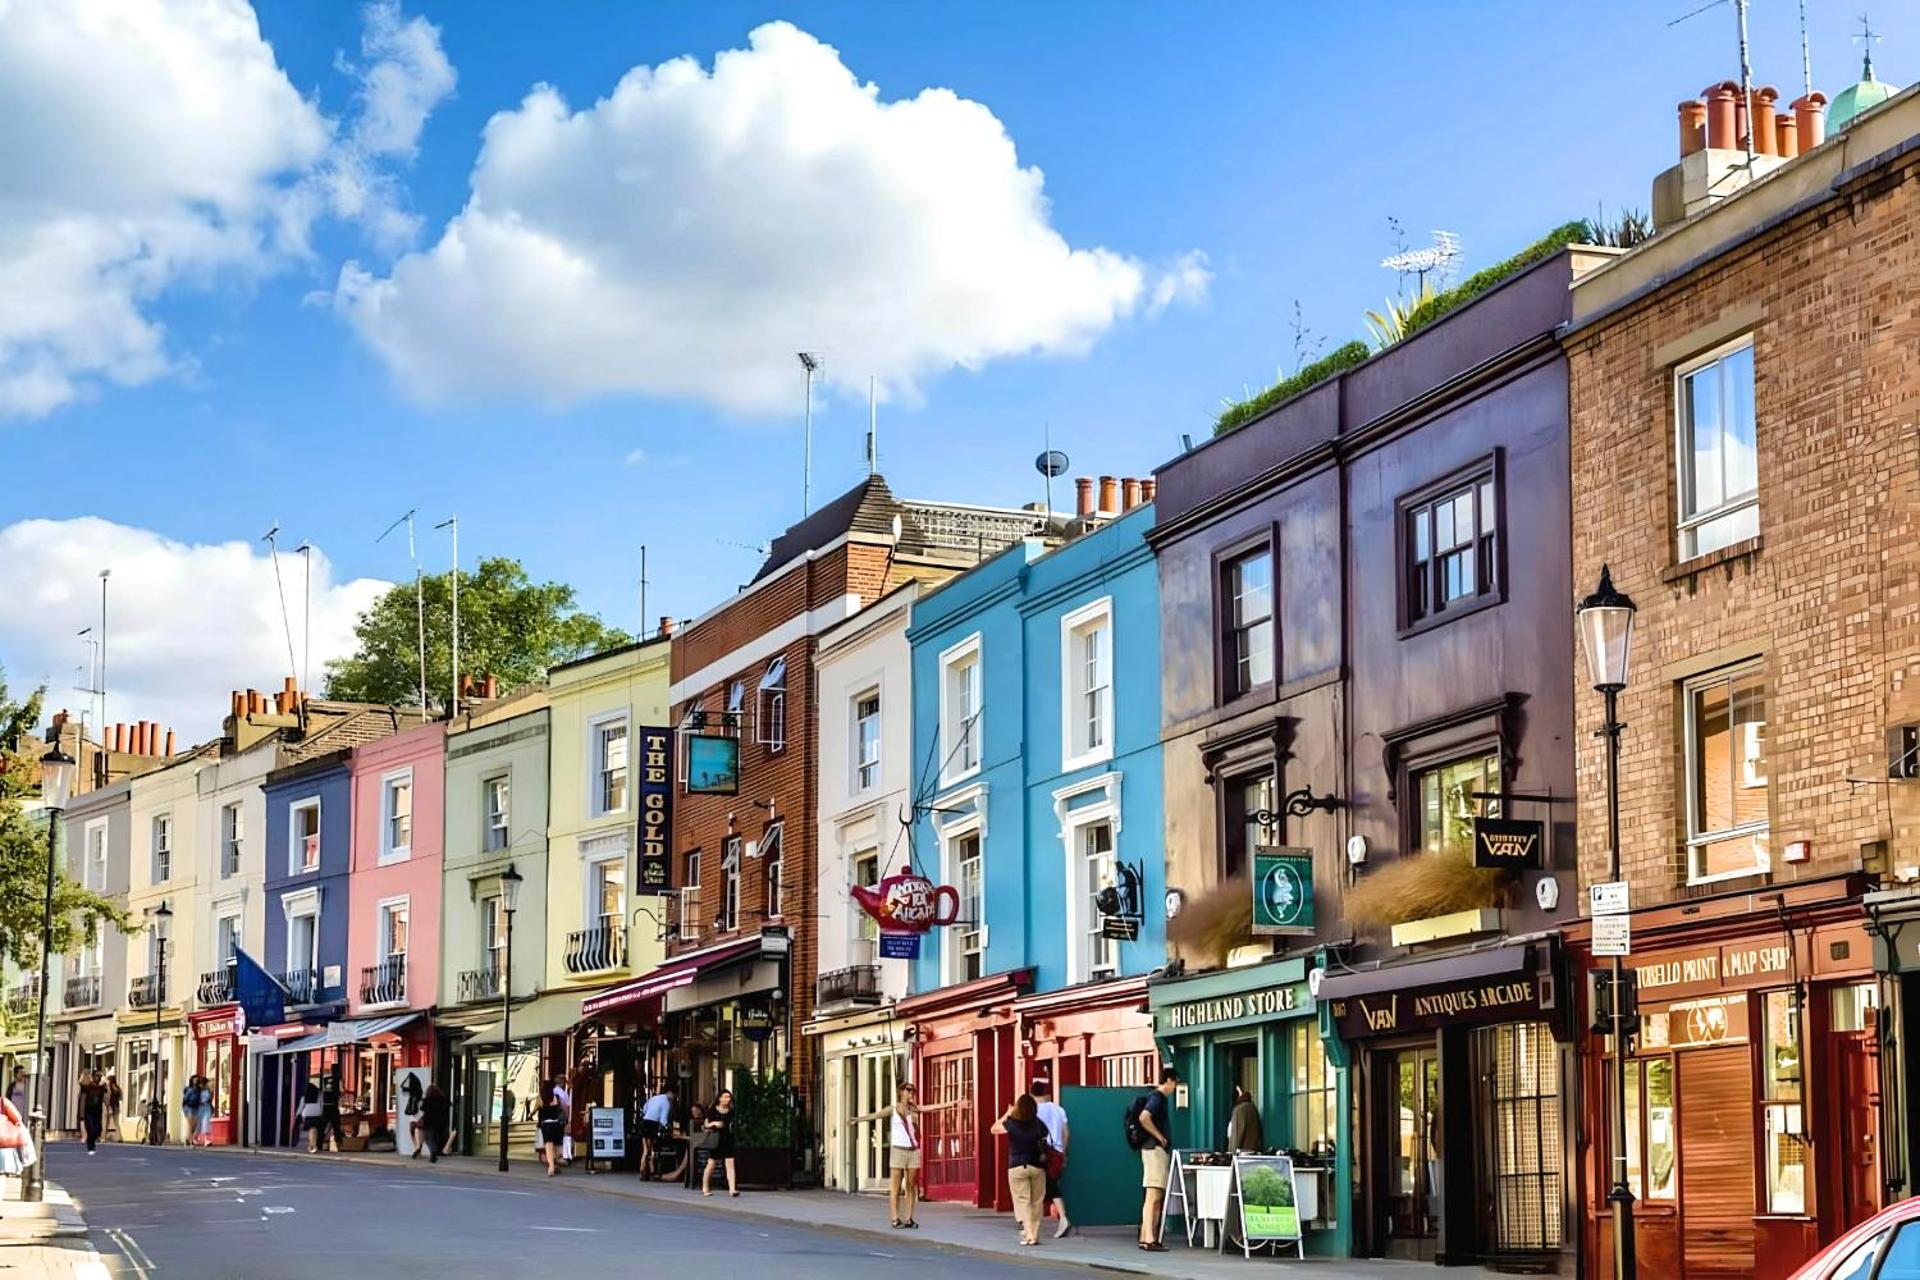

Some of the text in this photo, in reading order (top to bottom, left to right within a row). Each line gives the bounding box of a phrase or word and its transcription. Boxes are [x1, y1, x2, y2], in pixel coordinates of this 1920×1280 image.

[645, 736, 666, 782] THE
[643, 793, 665, 856] GOLD
[1480, 832, 1537, 856] VAN
[1683, 956, 1717, 983] PRINT
[1731, 951, 1758, 977] MAP
[1760, 946, 1790, 973] SHOP
[1171, 988, 1294, 1028] HIGHLAND STORE
[1359, 993, 1399, 1031] VAN
[1415, 990, 1477, 1016] ANTIQUES
[1480, 982, 1534, 1007] ARCADE
